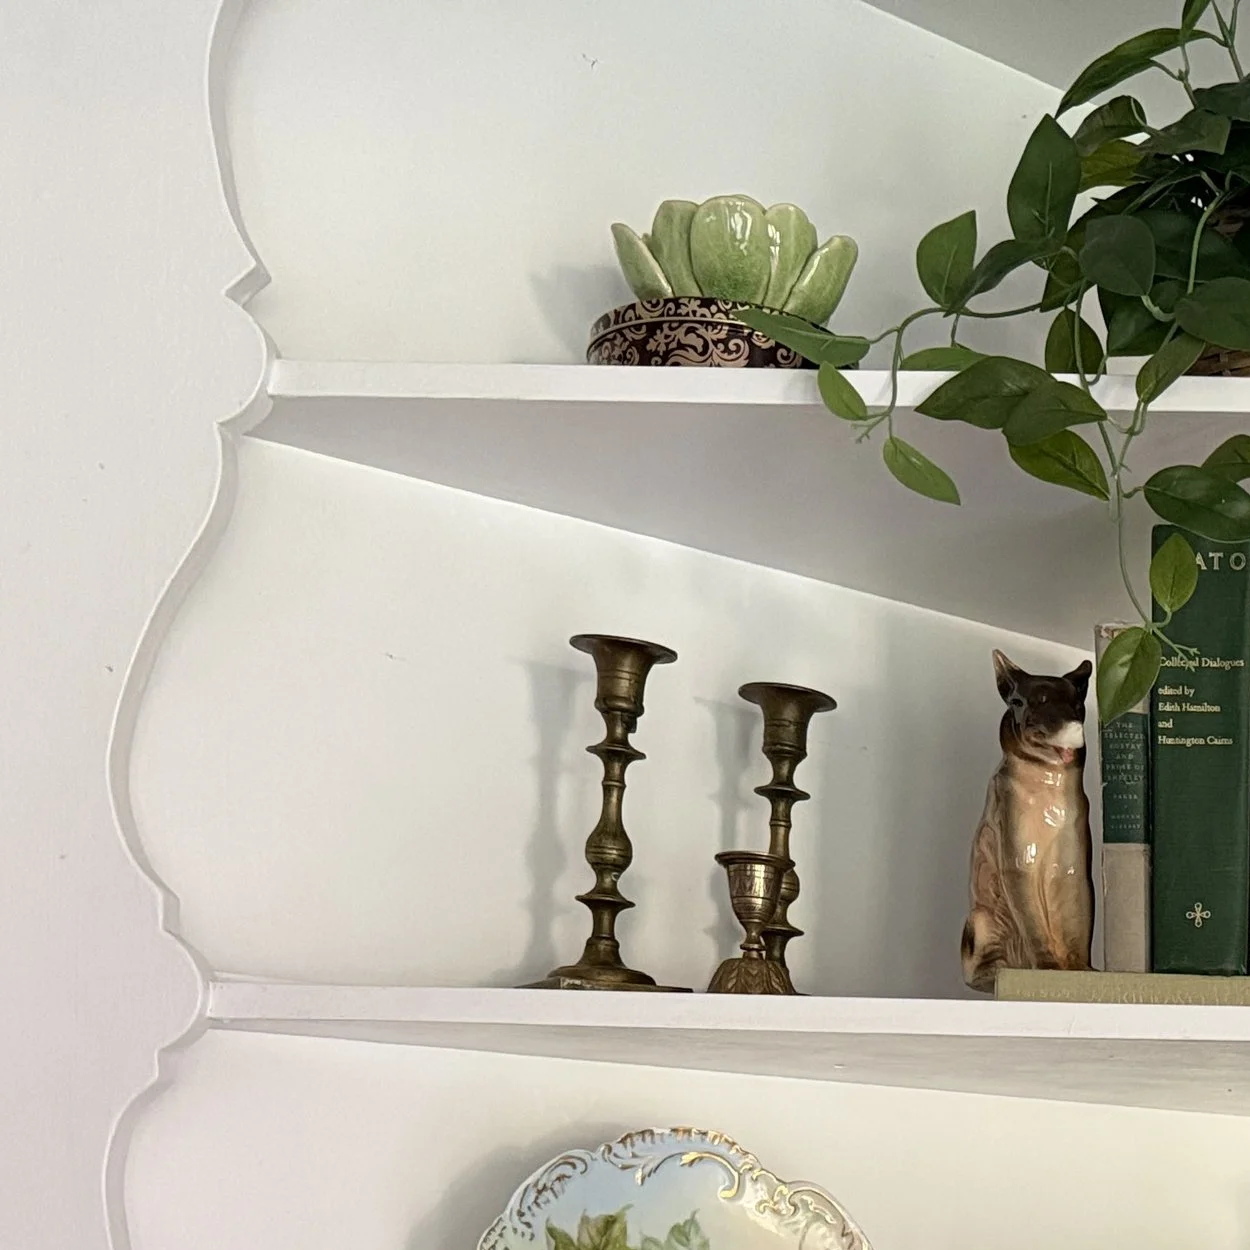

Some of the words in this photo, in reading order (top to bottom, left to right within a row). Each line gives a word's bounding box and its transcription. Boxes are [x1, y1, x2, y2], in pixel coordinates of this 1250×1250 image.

[1195, 551, 1247, 571] ATO
[1160, 656, 1199, 668] Collced
[1201, 657, 1245, 671] Dialogues
[1158, 685, 1182, 695] edited
[1184, 685, 1195, 697] by
[1158, 702, 1180, 712] Edith
[1182, 702, 1221, 712] Hamilton
[1158, 719, 1173, 728] and
[1158, 735, 1205, 747] Huntington
